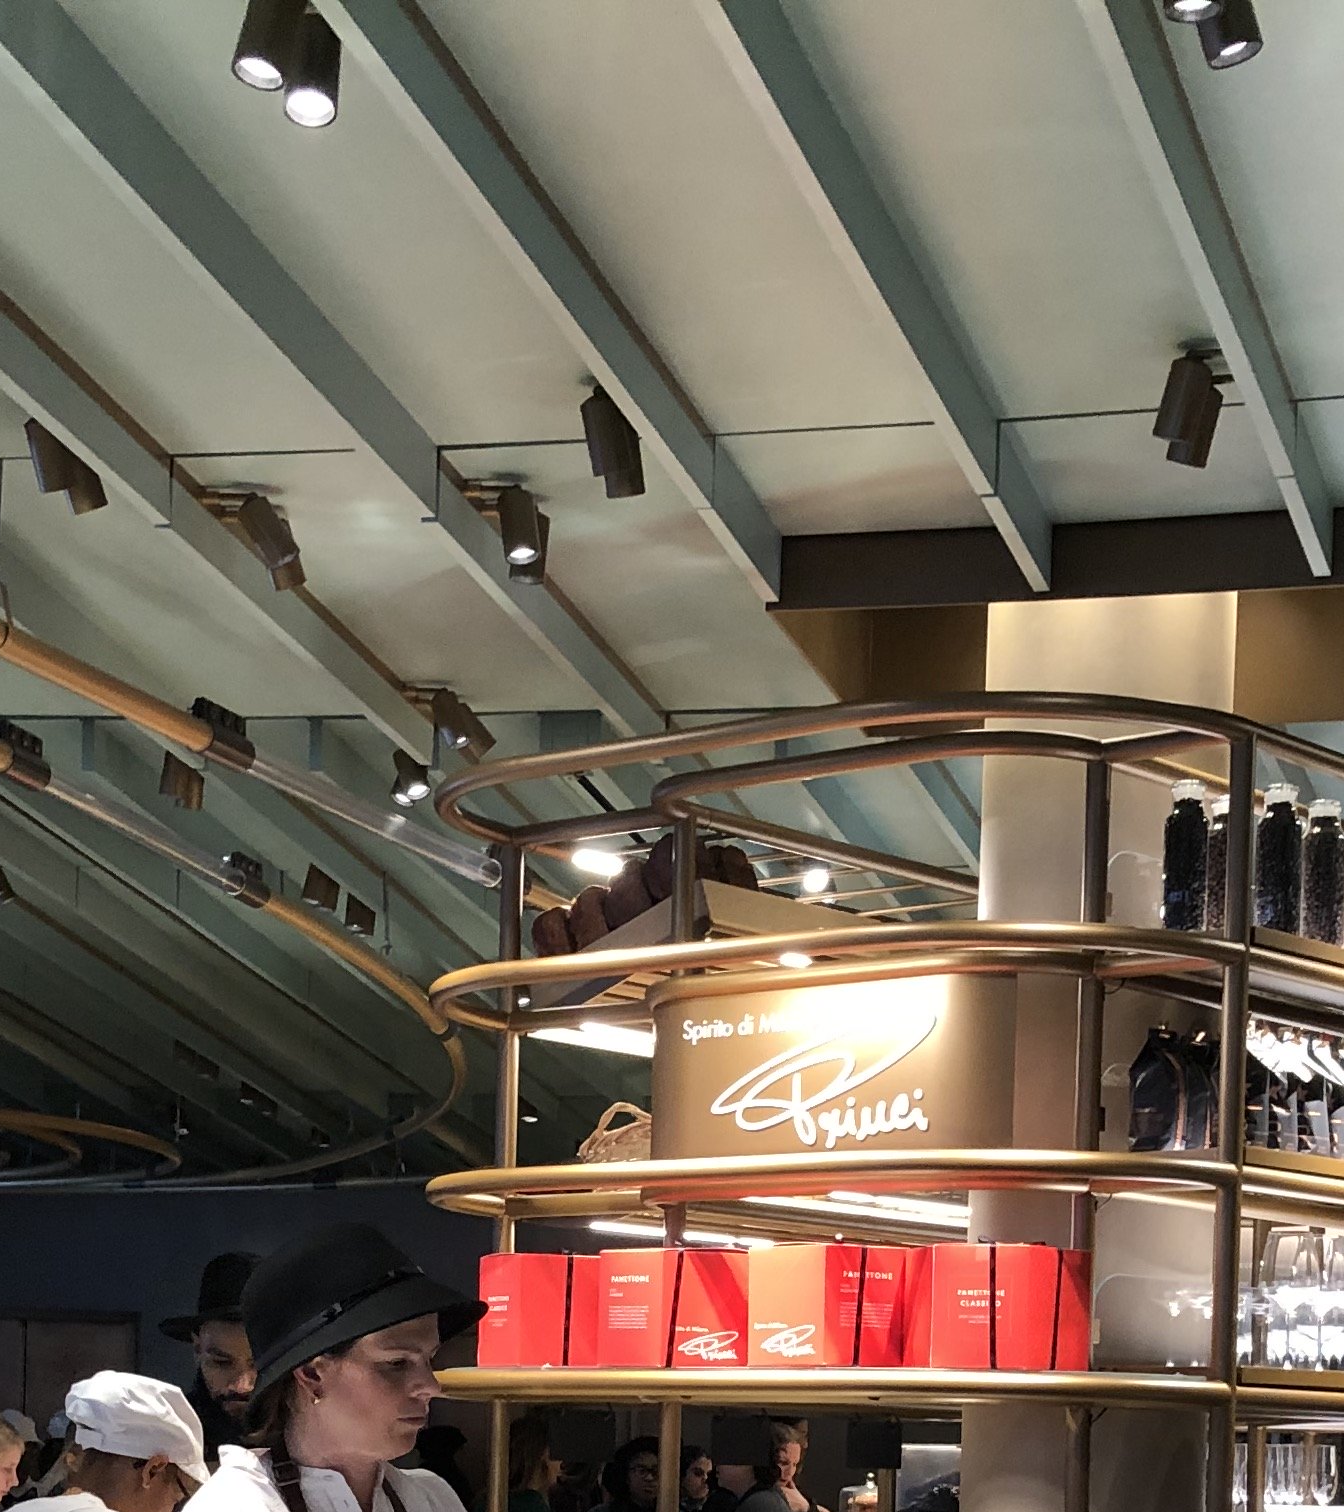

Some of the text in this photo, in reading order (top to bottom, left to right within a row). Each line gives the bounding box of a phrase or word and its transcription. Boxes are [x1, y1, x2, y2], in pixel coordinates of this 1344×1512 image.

[682, 1019, 734, 1045] Spirito
[737, 1013, 755, 1036] di
[842, 1270, 893, 1280] PANTTONE
[957, 1289, 1006, 1297] PANETTNE
[959, 1299, 1002, 1307] CLASSIO
